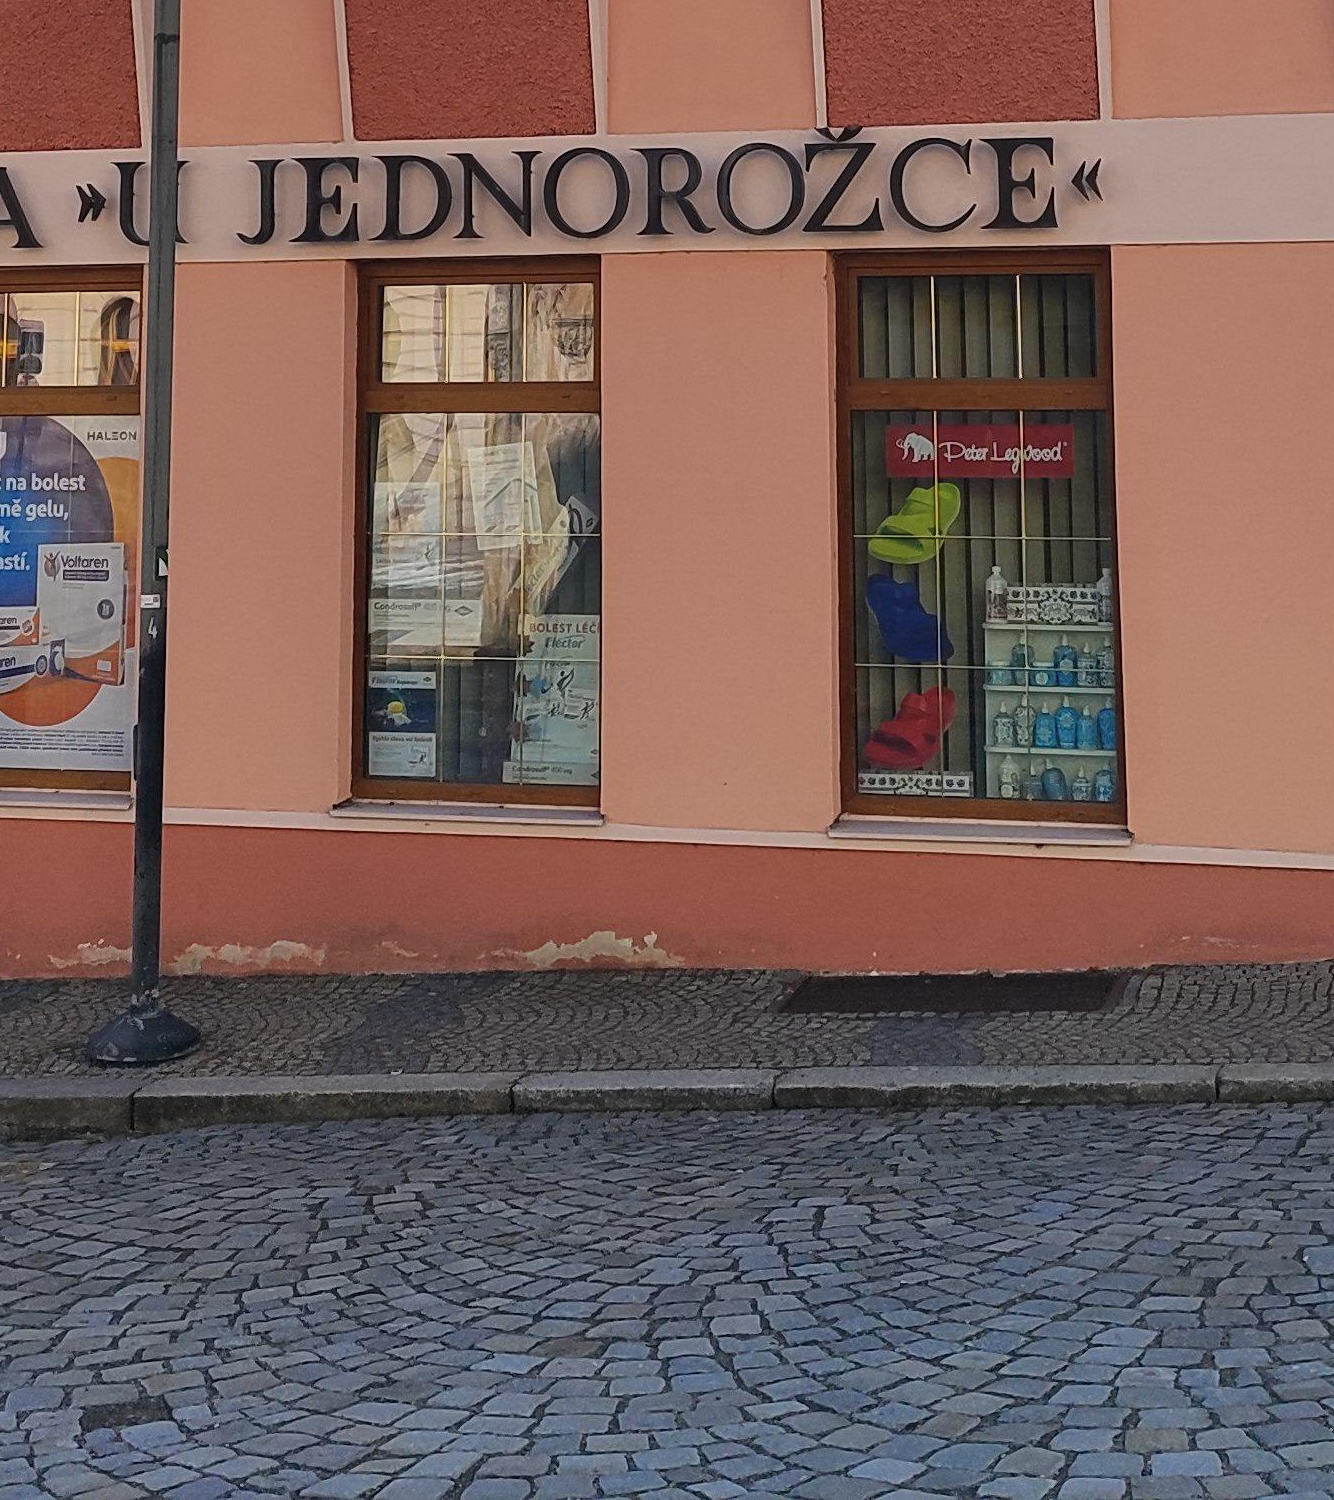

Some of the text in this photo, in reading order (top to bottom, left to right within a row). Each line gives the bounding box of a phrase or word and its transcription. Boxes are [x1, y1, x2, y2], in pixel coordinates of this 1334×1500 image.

[86, 430, 137, 442] HALEON
[938, 441, 987, 463] Peter
[5, 476, 27, 492] na
[31, 472, 87, 492] bolest
[25, 499, 69, 521] gelu,
[61, 555, 109, 568] Voltaren
[147, 616, 158, 639] 4
[529, 619, 599, 634] BOLEST LÉČ
[544, 635, 585, 649] Flector
